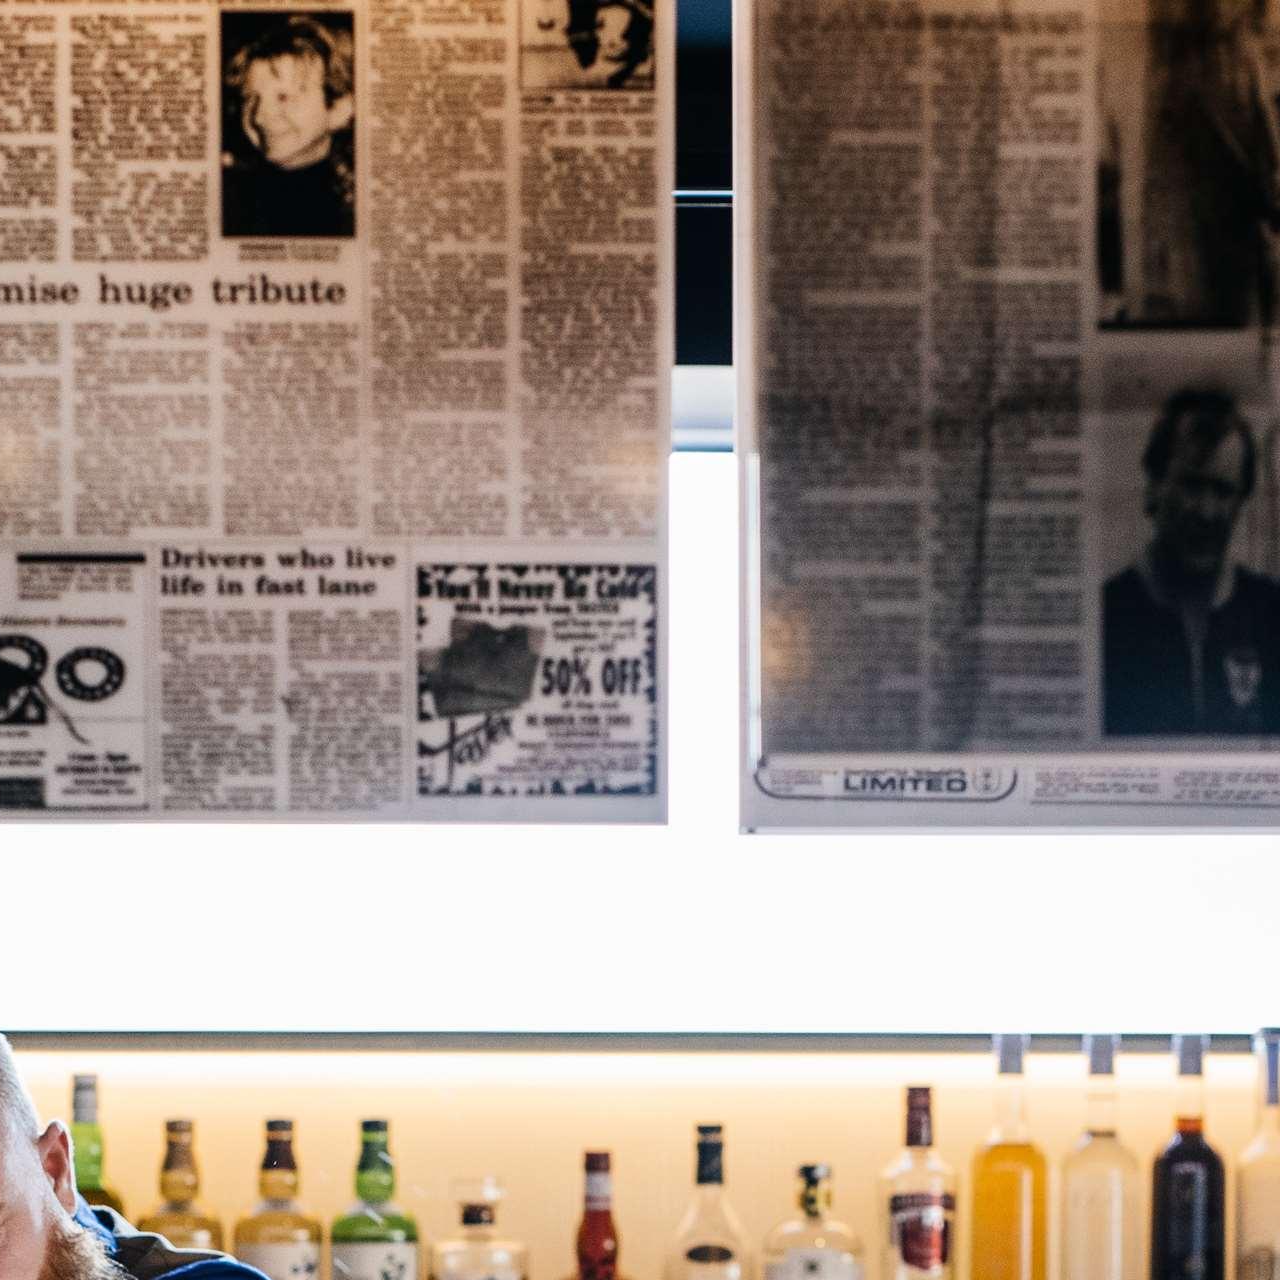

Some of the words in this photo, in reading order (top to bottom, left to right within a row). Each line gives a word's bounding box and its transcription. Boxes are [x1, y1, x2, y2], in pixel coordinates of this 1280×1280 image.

[100, 276, 193, 310] huge
[211, 275, 346, 305] tribute
[161, 548, 265, 570] Drivers
[277, 549, 334, 568] who
[345, 548, 397, 568] live
[161, 576, 204, 597] life
[217, 576, 244, 596] in
[256, 576, 306, 597] fast
[318, 577, 377, 597] lane
[542, 657, 592, 696] 50%
[602, 657, 642, 696] OFF
[843, 773, 967, 793] LIMITED
